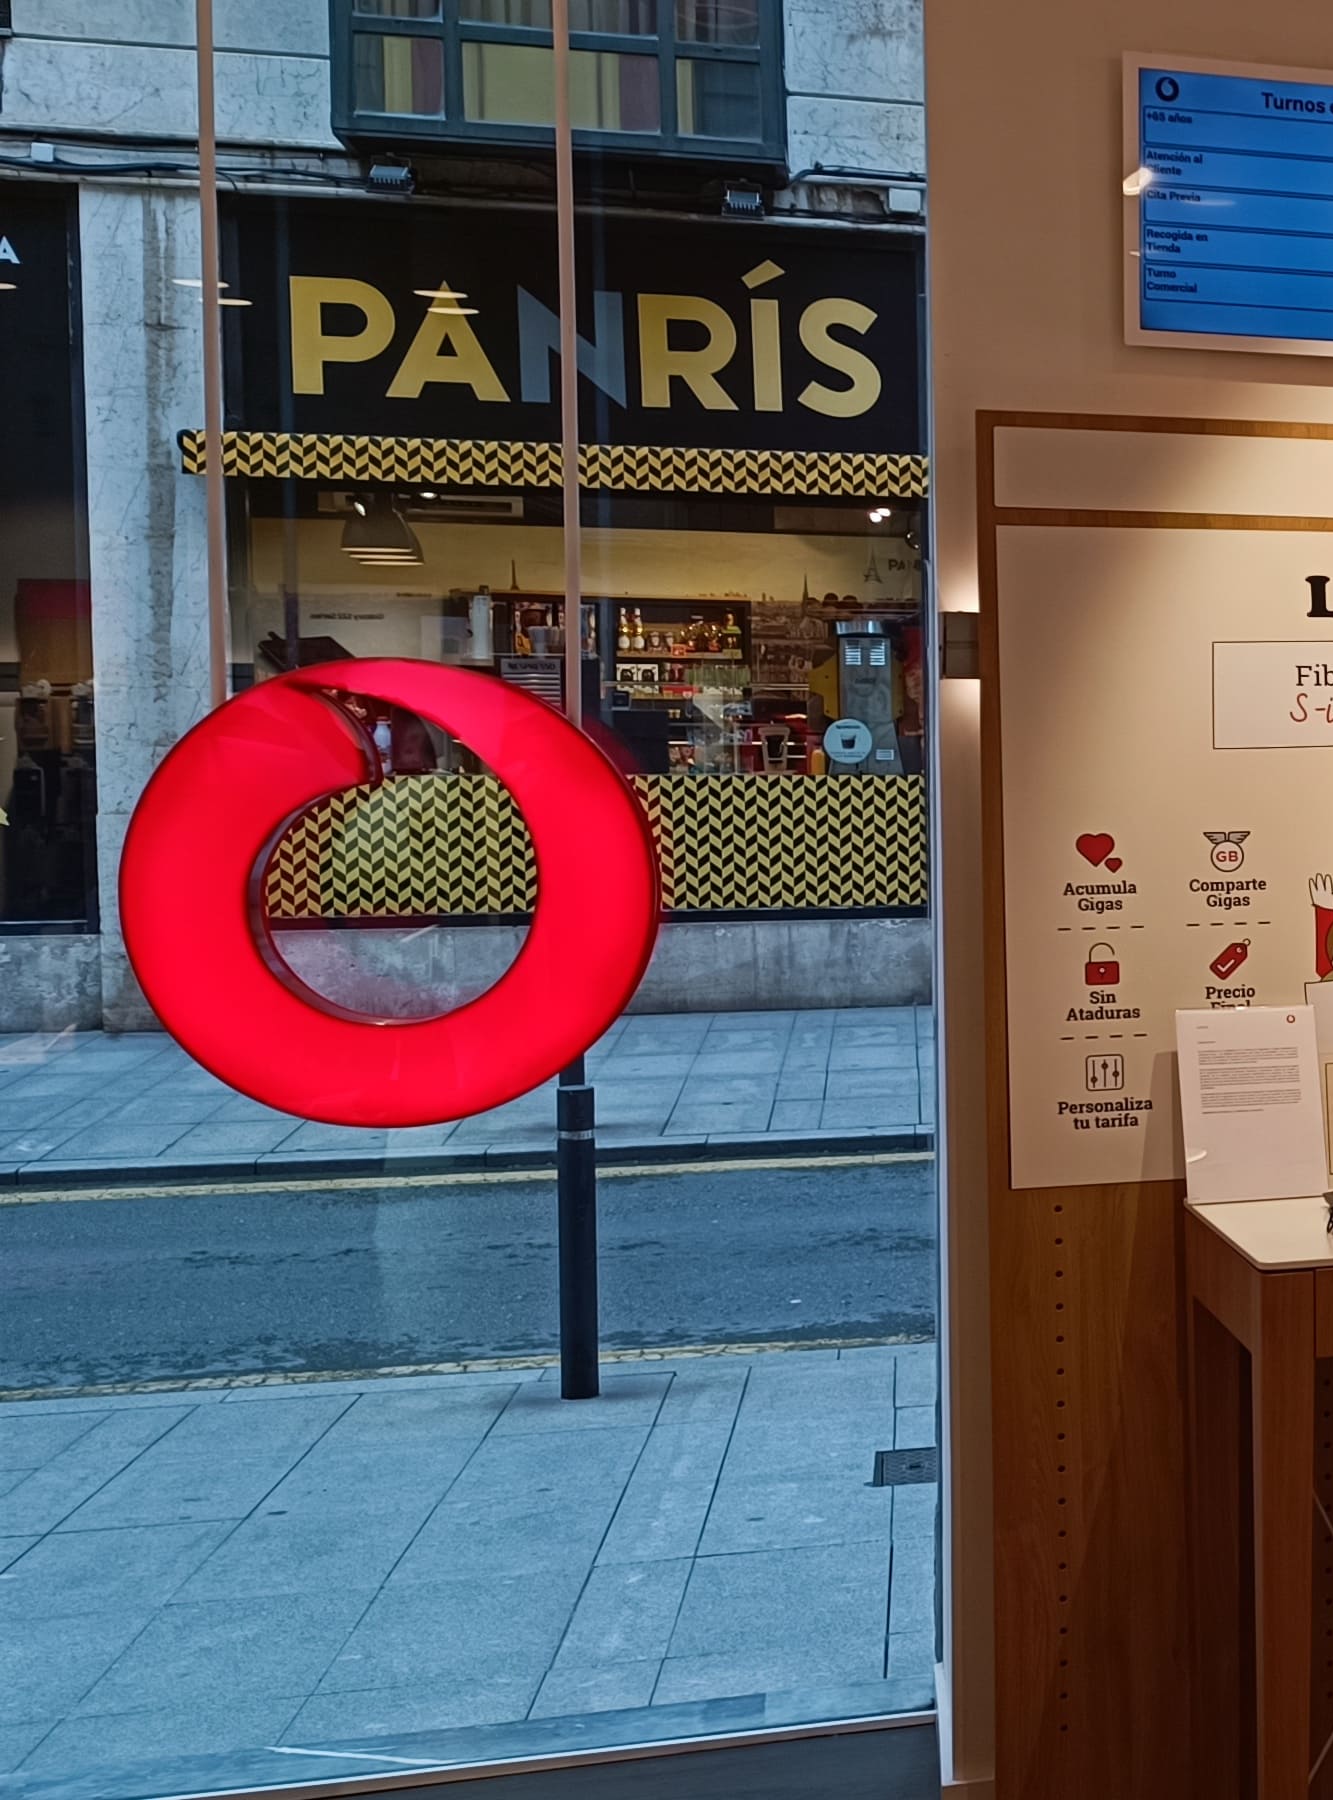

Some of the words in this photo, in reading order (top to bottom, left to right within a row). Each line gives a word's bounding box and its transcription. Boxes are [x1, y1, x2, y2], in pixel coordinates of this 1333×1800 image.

[1261, 92, 1326, 114] Turnos
[1146, 151, 1192, 163] Atención
[1146, 190, 1167, 200] Cita
[1169, 191, 1201, 202] Previa
[1147, 229, 1194, 242] Recogida
[1147, 242, 1182, 253] Tienda
[1147, 281, 1198, 293] Comercial
[289, 259, 882, 419] PANRÍS
[1215, 850, 1239, 863] GB
[1063, 880, 1138, 897] Acumula
[1188, 878, 1268, 894] Comparte
[1077, 897, 1124, 914] Gigas
[1206, 894, 1251, 911] Gigas
[1089, 990, 1117, 1005] Sin
[1205, 983, 1256, 999] Precio
[1066, 1006, 1141, 1022] Ataduras
[1058, 1097, 1153, 1115] Personaliza
[1073, 1117, 1090, 1130] tu
[1095, 1114, 1139, 1129] tarifa
